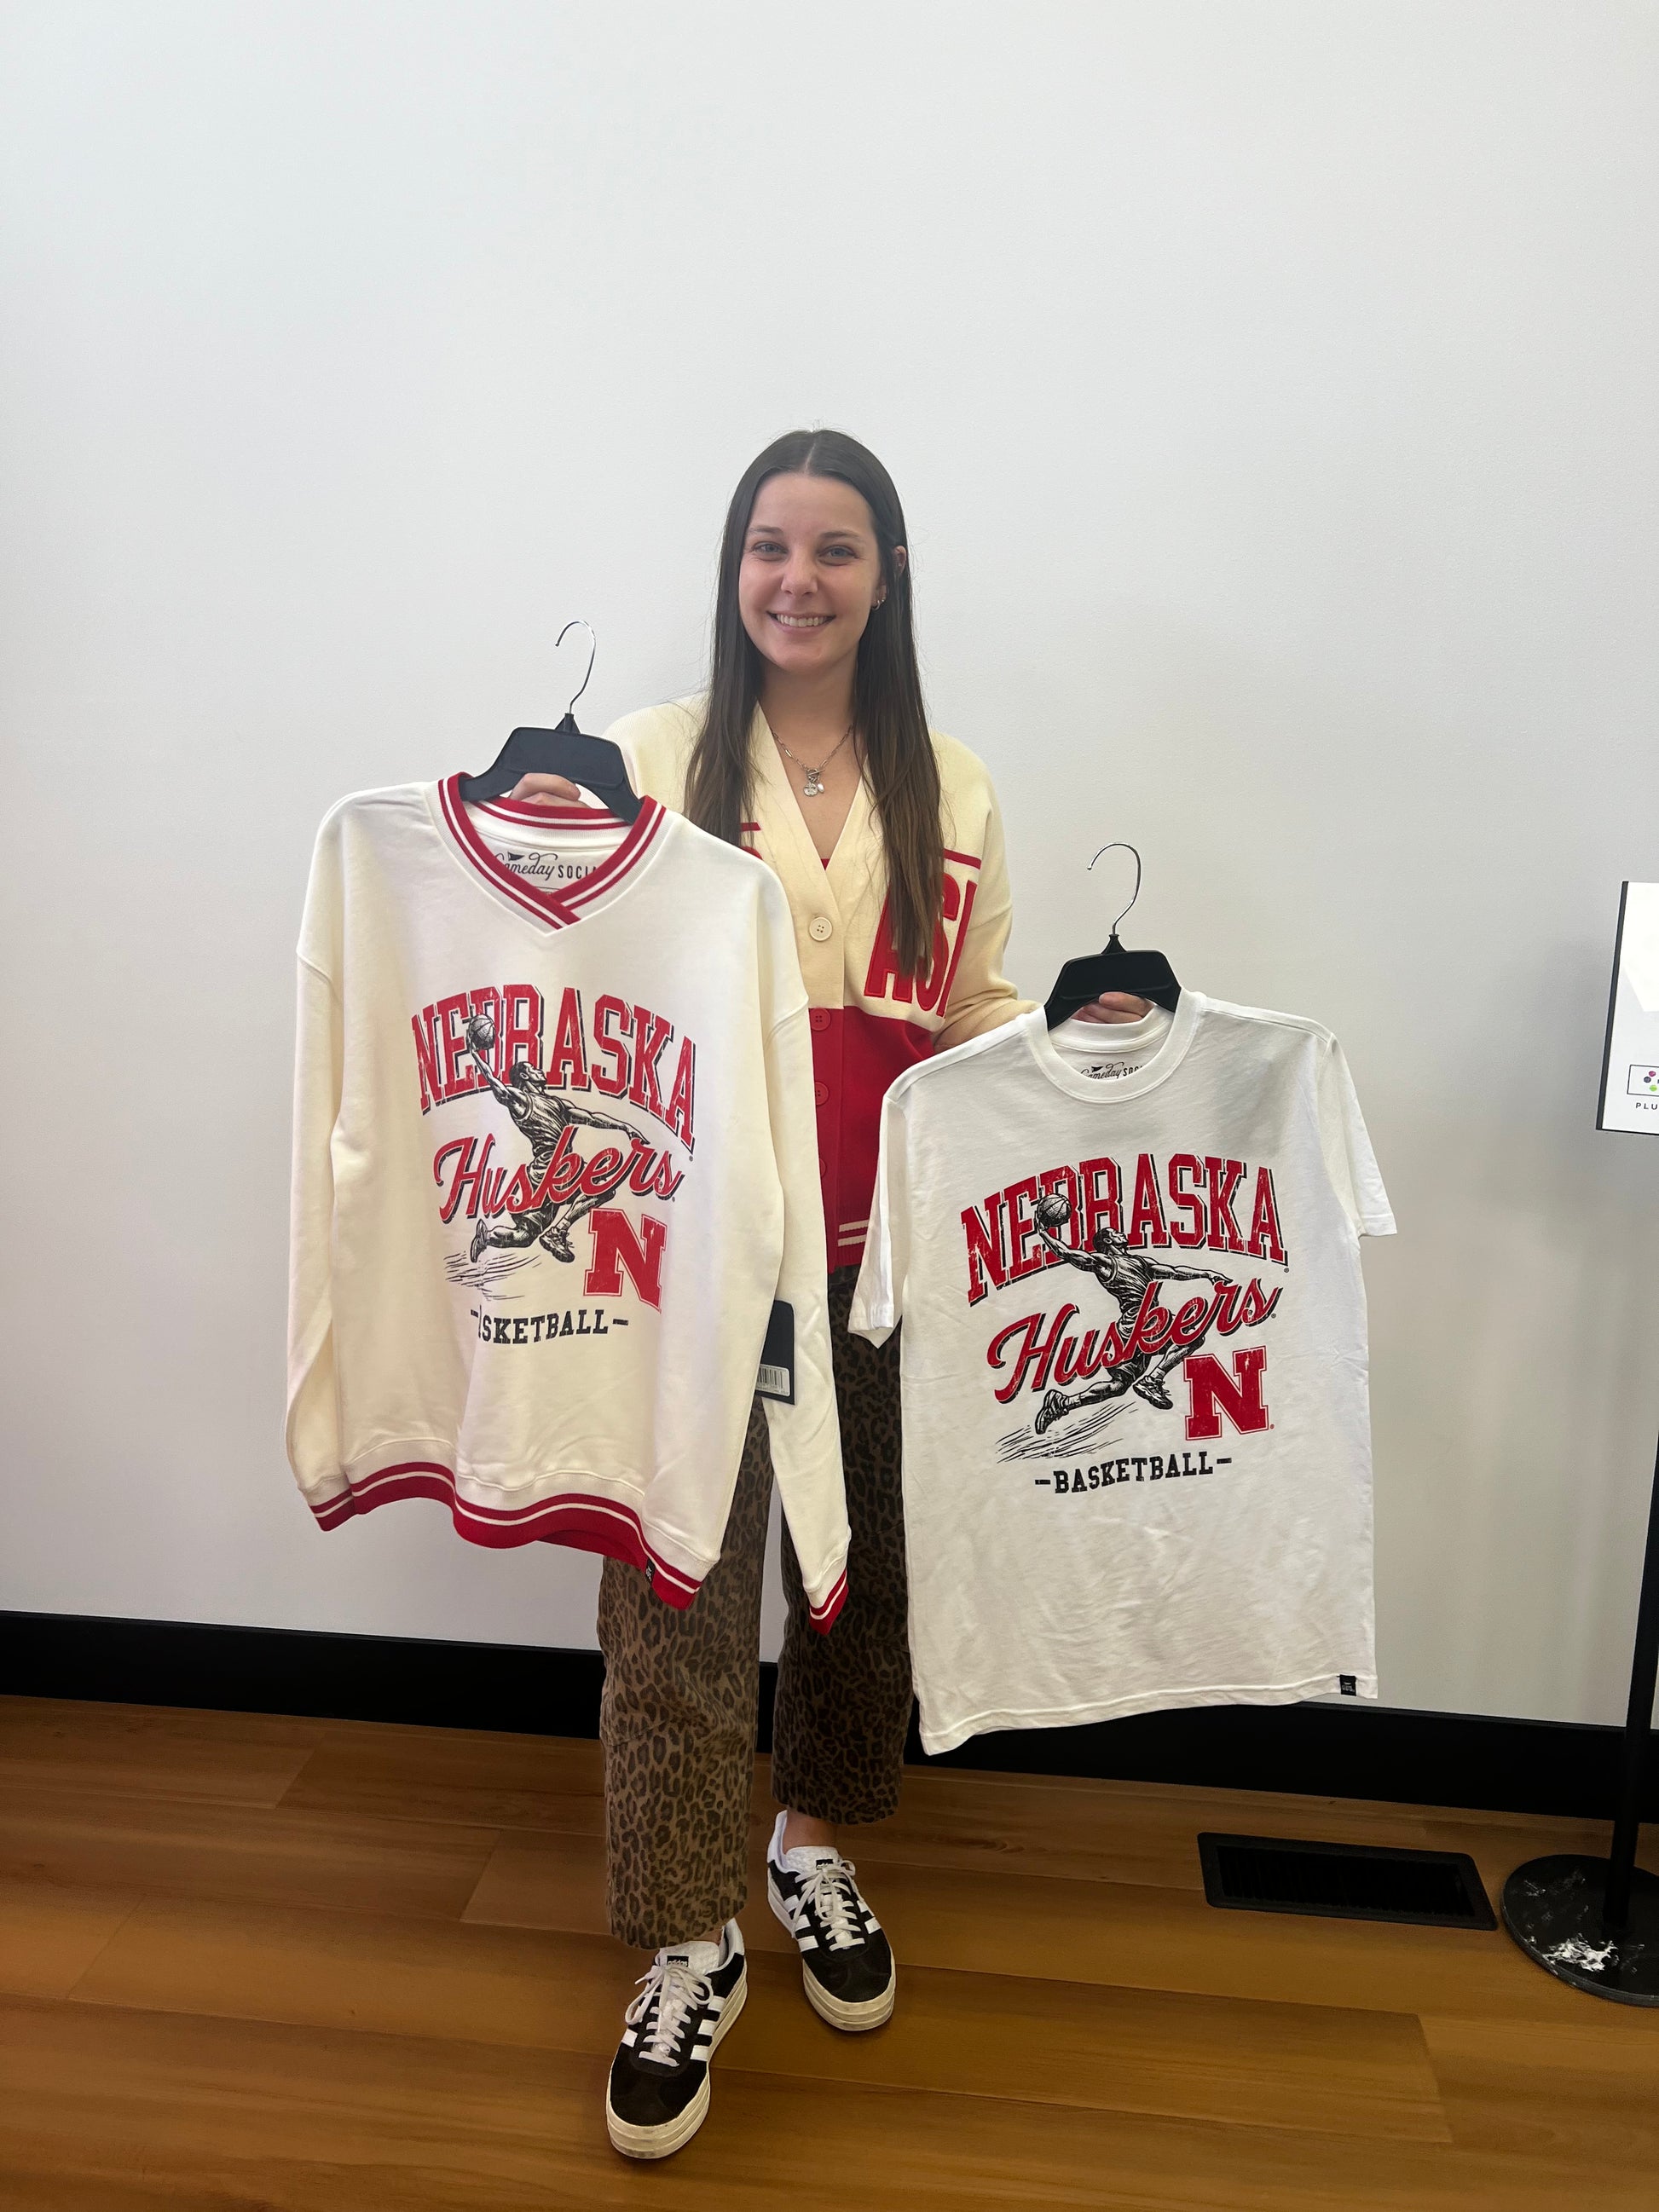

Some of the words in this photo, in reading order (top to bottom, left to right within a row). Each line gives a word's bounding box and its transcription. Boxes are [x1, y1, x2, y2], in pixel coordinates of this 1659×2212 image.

[494, 852, 558, 881] ameday
[558, 864, 597, 880] SOCI
[411, 984, 696, 1152] NEBRASKA
[433, 1126, 685, 1224] Huskers
[583, 1208, 668, 1314] N
[961, 1153, 1288, 1308] NEBRASKA
[986, 1278, 1283, 1405] Huskers
[1184, 1345, 1269, 1441] N
